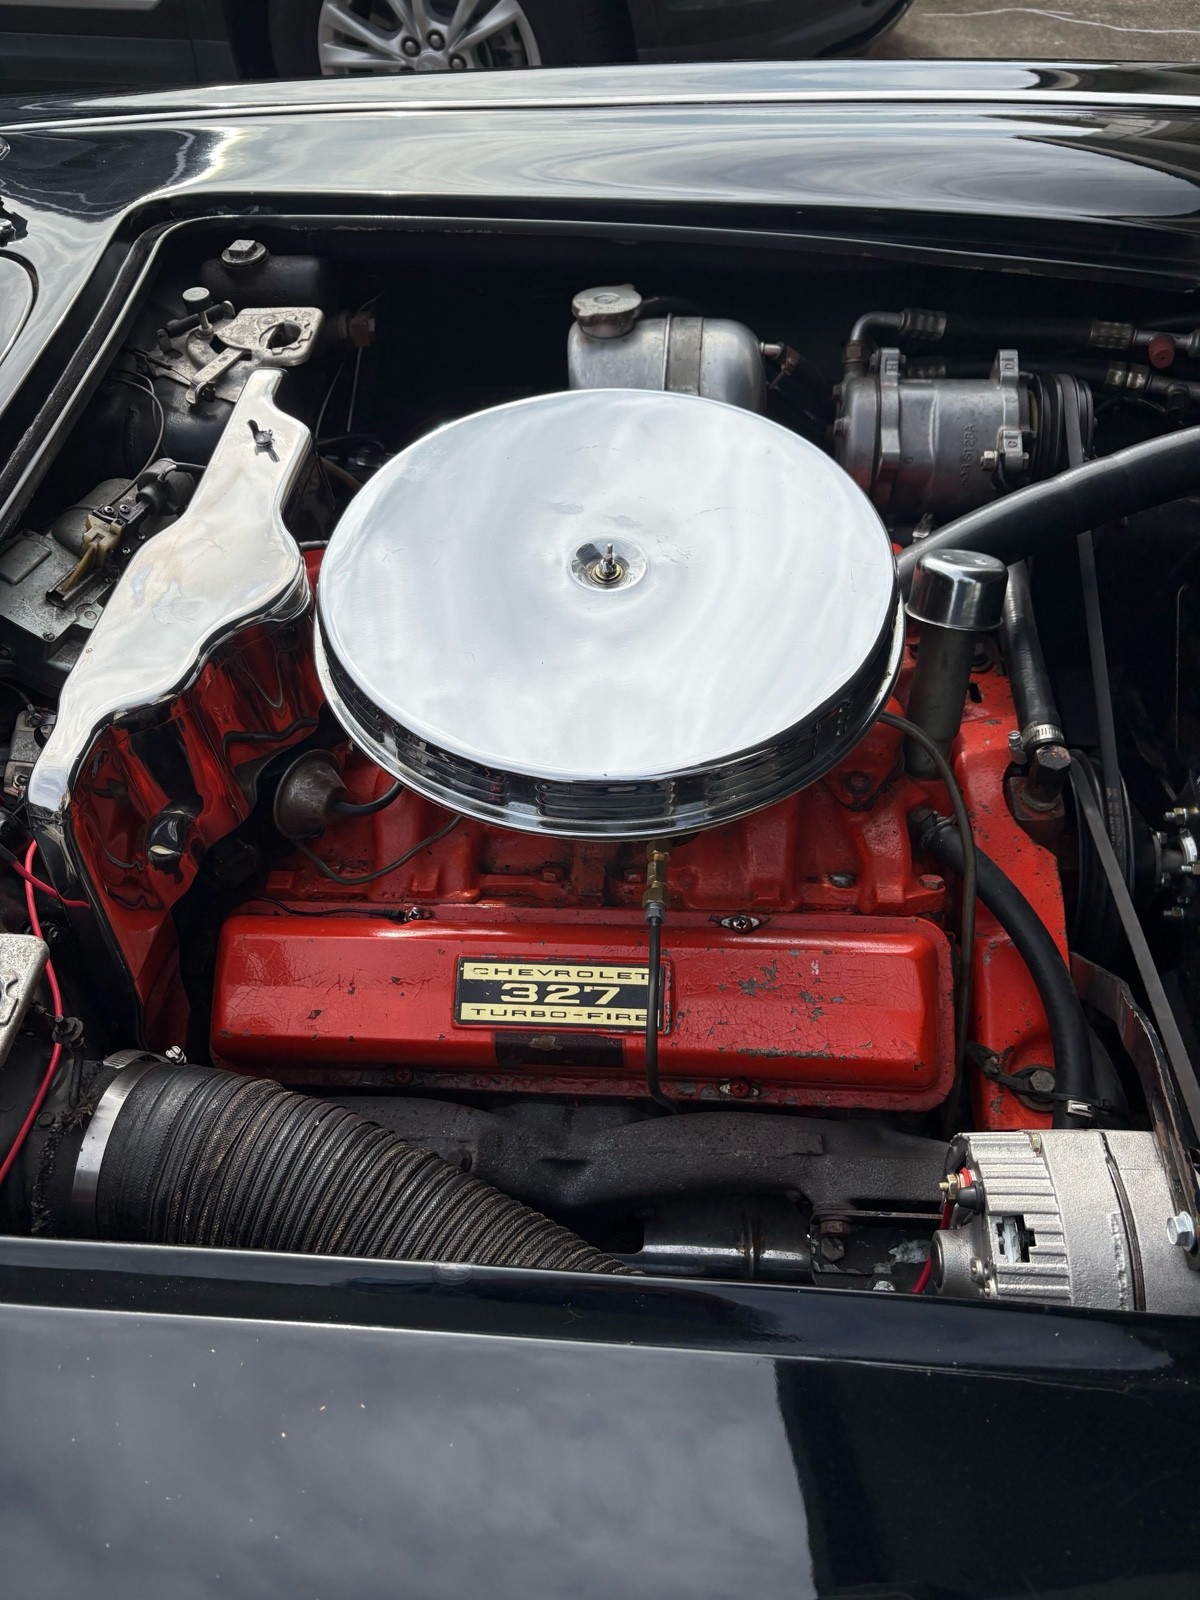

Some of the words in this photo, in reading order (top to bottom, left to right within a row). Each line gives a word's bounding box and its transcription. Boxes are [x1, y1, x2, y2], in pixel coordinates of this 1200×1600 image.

[473, 967, 650, 980] CHEVROLET
[500, 982, 621, 1005] 327
[470, 1008, 648, 1022] TURBO-FIRE
